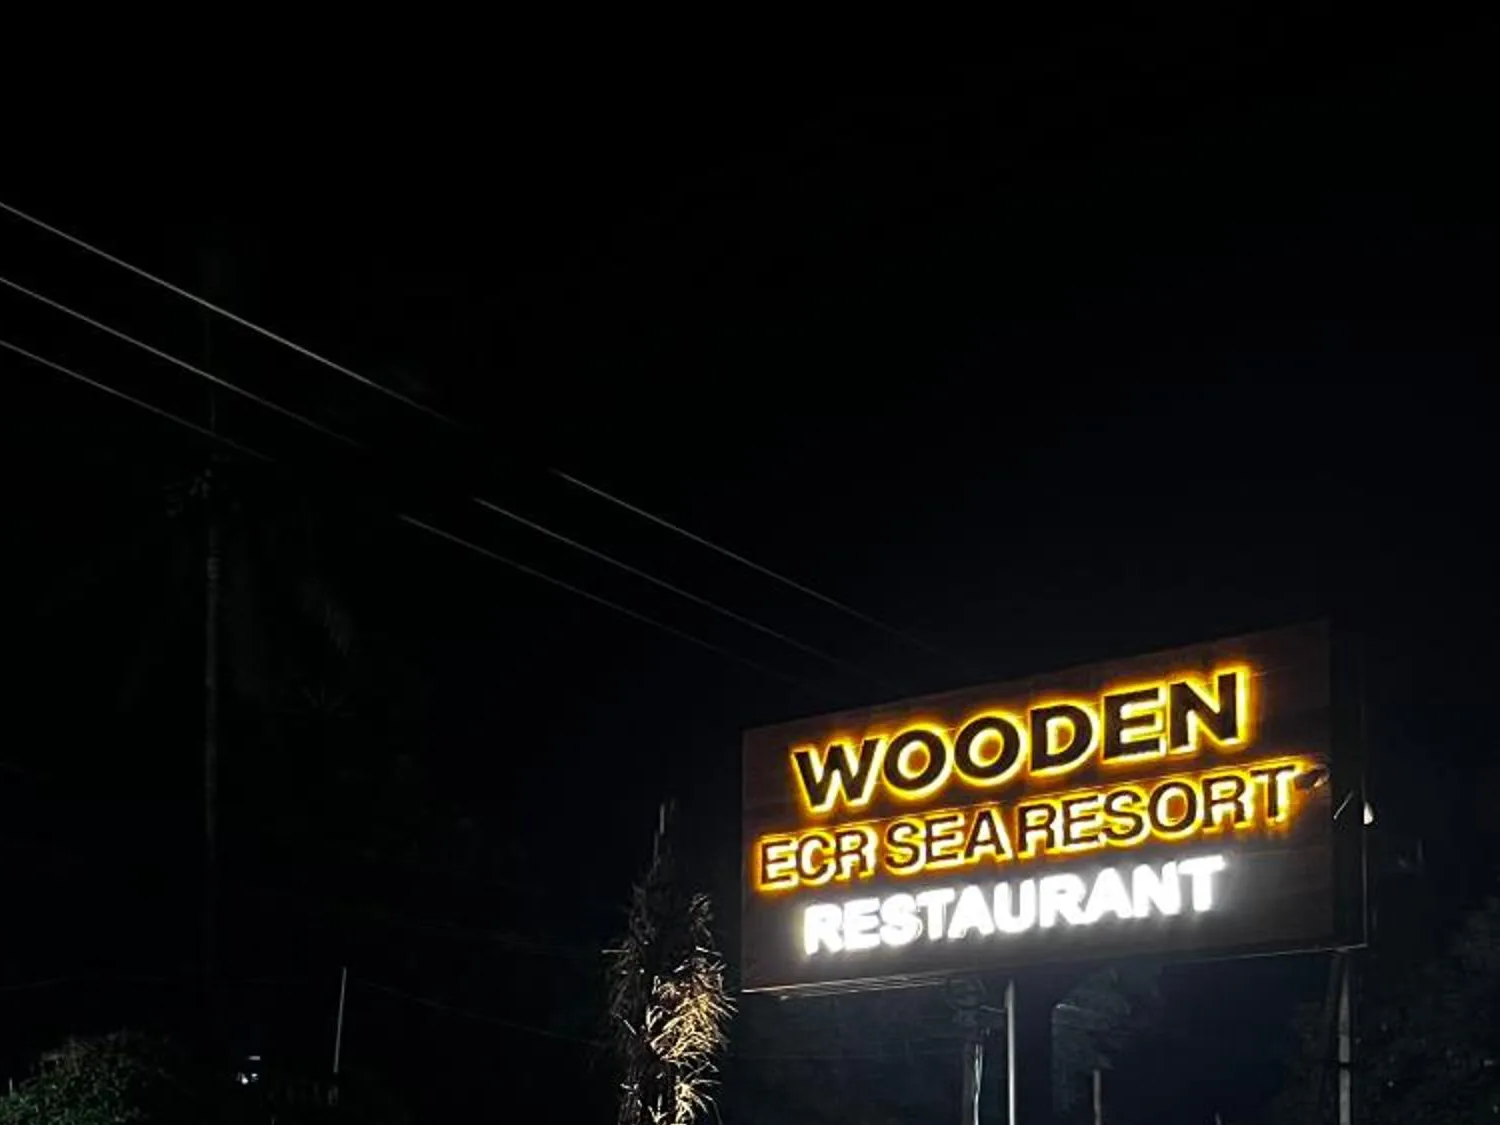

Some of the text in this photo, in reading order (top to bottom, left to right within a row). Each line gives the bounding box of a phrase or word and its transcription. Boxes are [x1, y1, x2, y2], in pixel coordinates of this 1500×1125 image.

[793, 670, 1250, 813] WOODEN
[759, 764, 1303, 890] ECR SEA RESORT
[803, 856, 1225, 954] RESTAURANT
